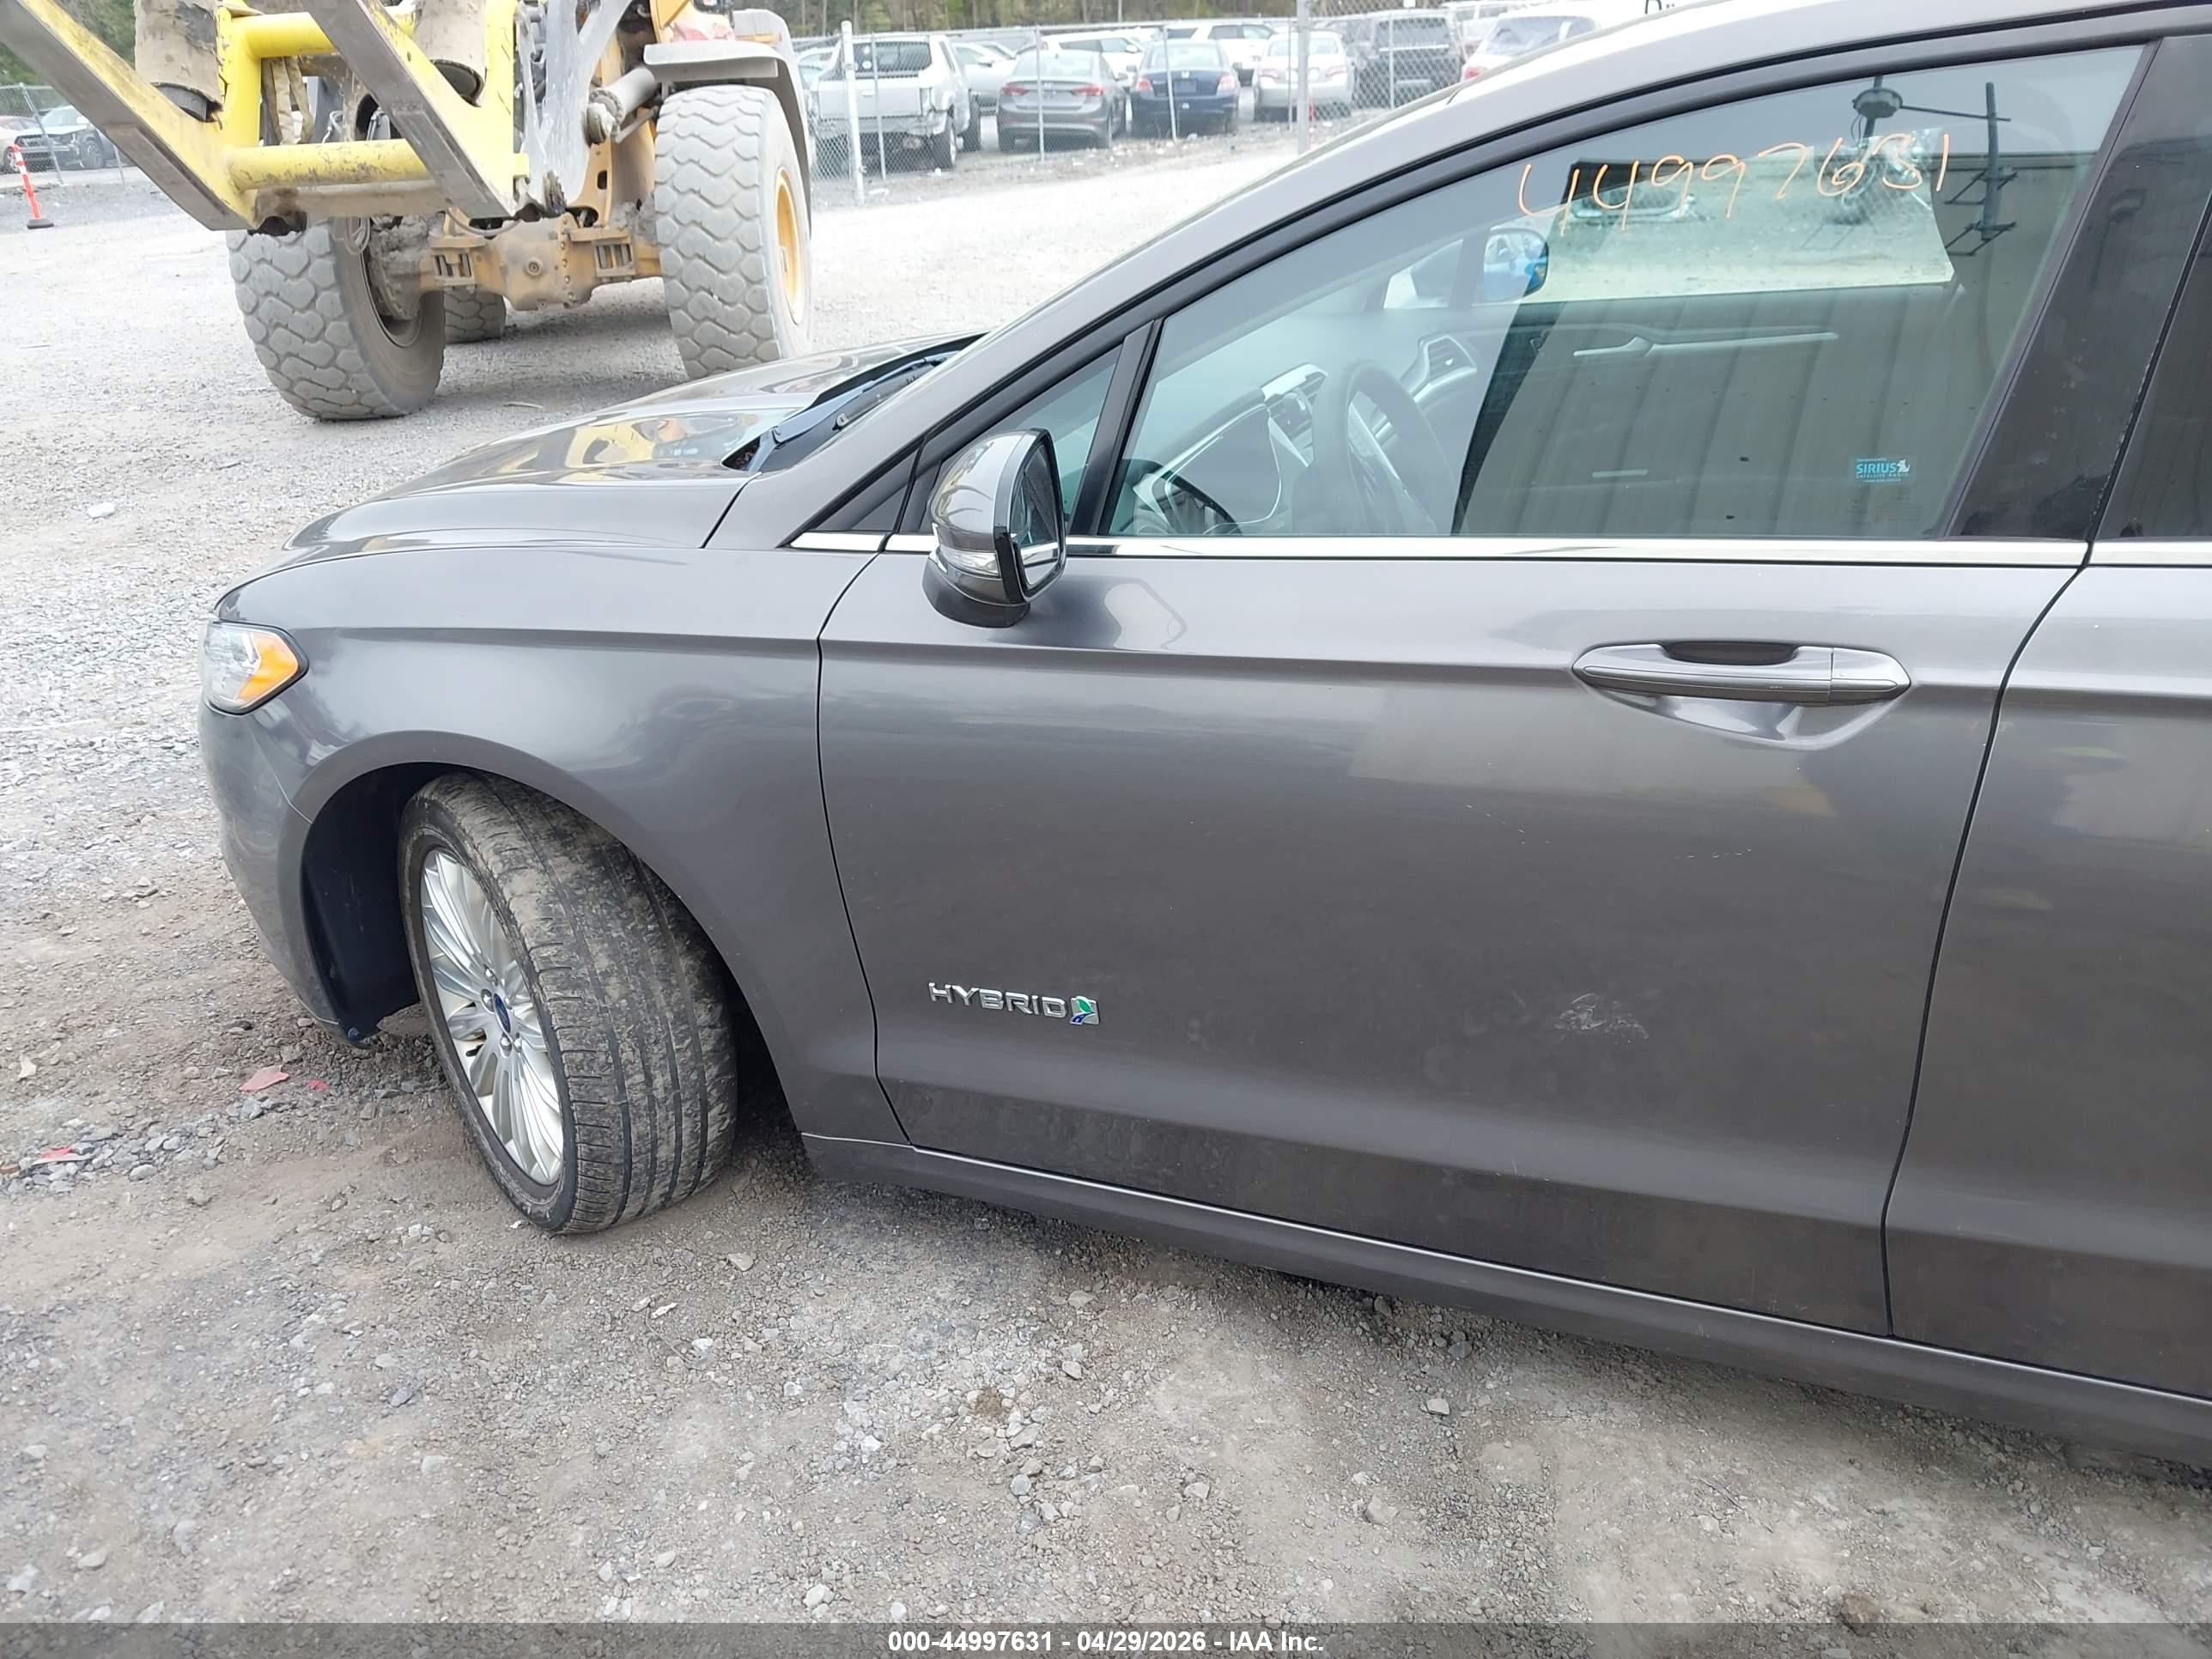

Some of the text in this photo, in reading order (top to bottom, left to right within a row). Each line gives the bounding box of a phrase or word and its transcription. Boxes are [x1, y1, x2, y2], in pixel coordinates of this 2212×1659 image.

[1518, 133, 1950, 237] 44997631
[1856, 462, 1897, 474] SIRIUS
[927, 981, 1067, 1019] HYBRID
